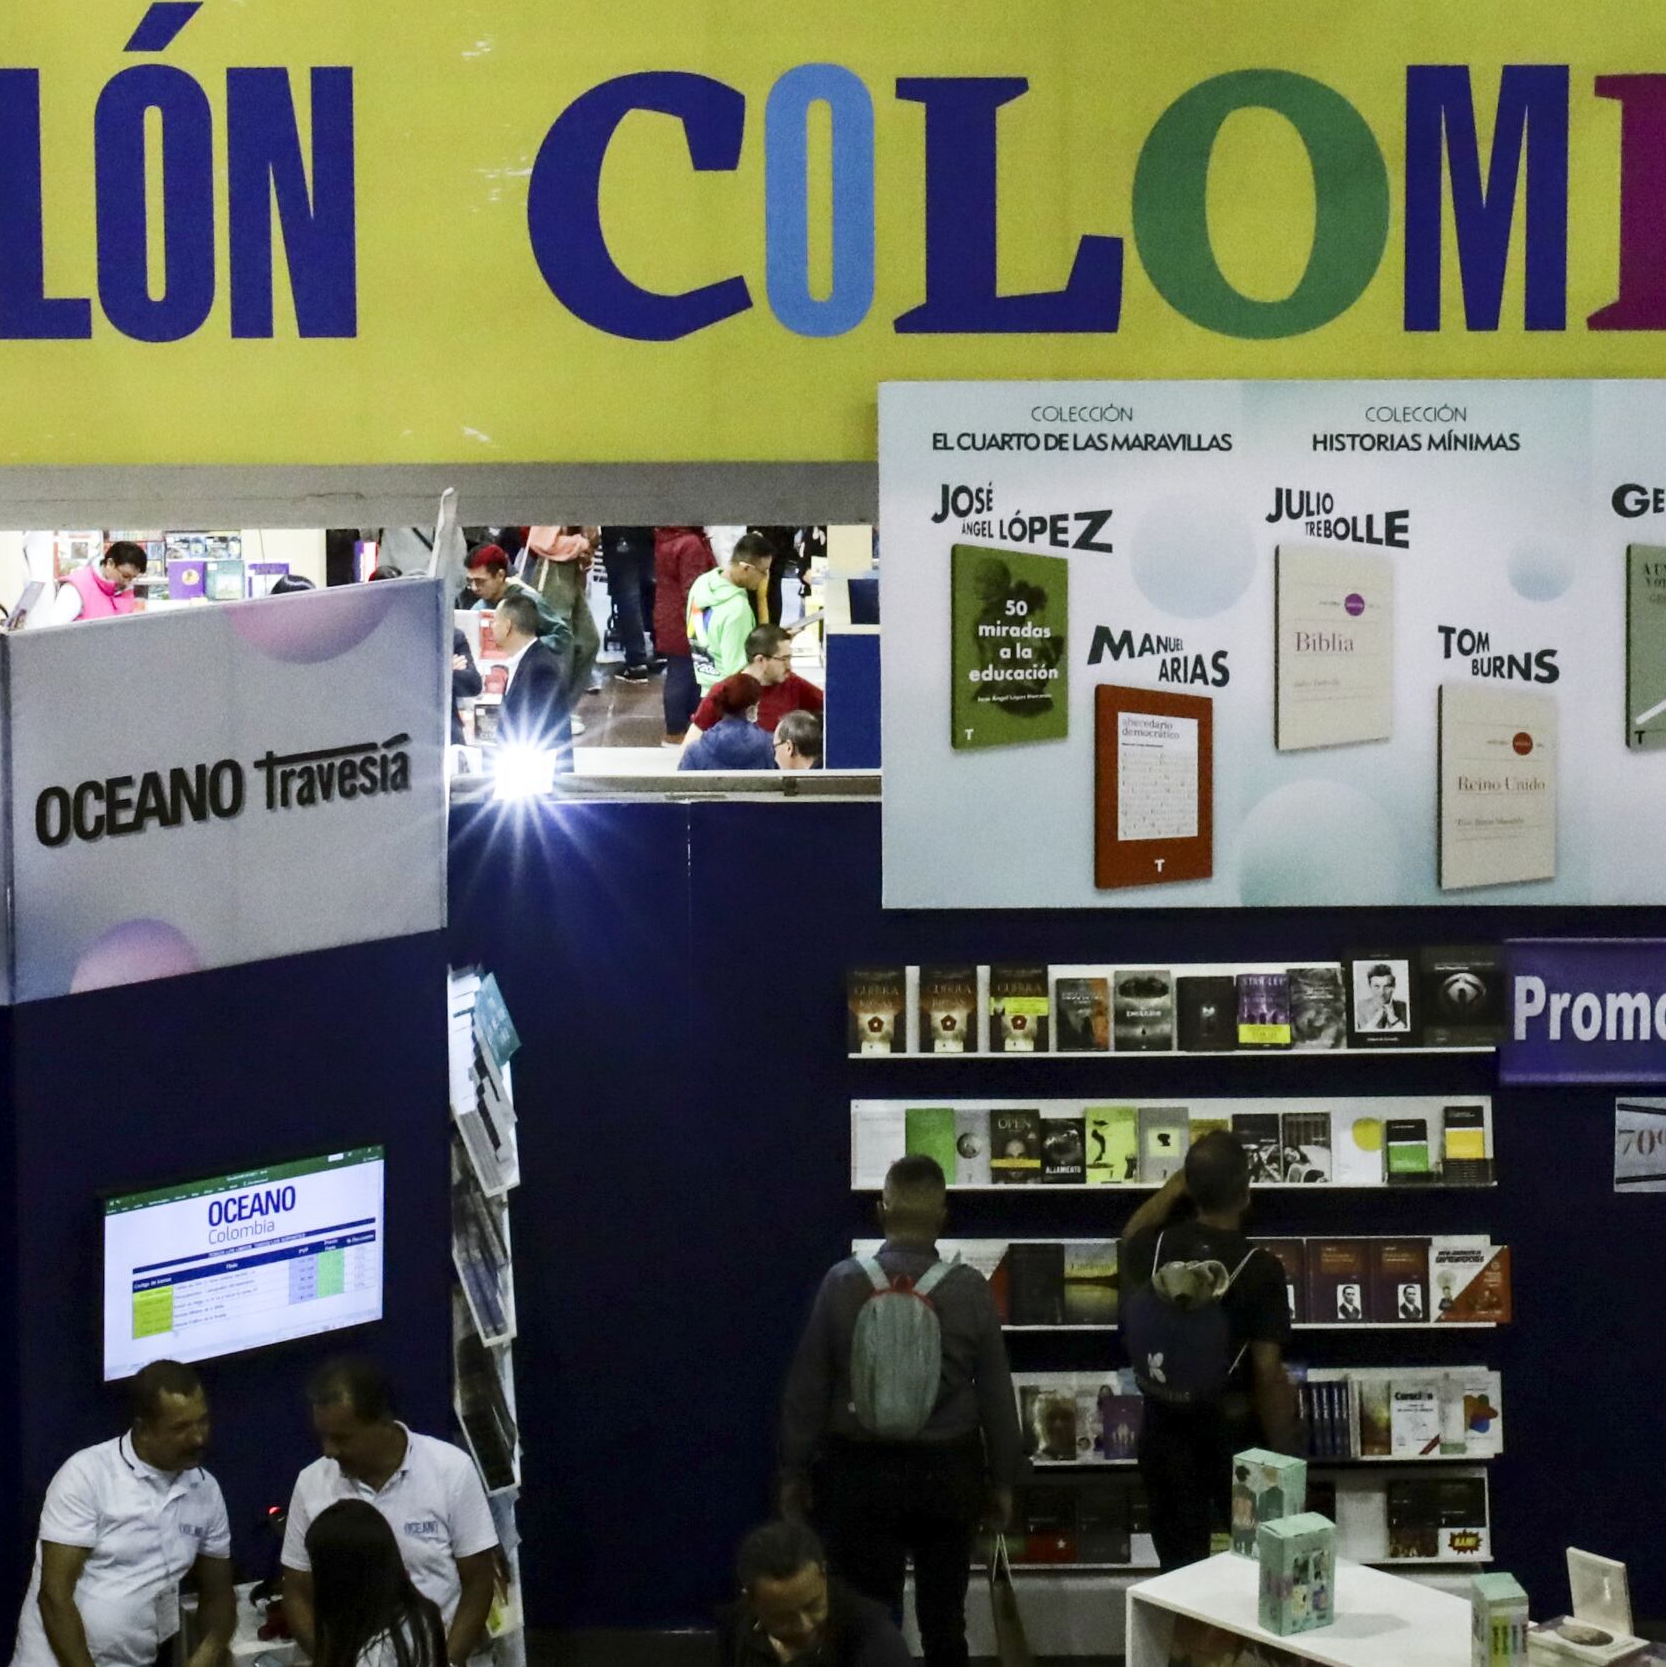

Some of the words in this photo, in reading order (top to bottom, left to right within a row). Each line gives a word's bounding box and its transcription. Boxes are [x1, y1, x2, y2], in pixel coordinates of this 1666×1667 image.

[1031, 403, 1134, 423] COLECCIÓN
[1365, 403, 1467, 423] COLECCIÓN
[932, 432, 954, 452] EL
[955, 432, 1041, 452] CUARTO
[1043, 432, 1069, 452] DE
[1071, 432, 1110, 452] LAS
[1111, 432, 1234, 452] MARAVILLAS
[1312, 432, 1422, 452] HISTORIAS
[1427, 428, 1521, 452] MÍNIMAS
[931, 482, 993, 524] JOSÉ
[1266, 486, 1334, 524] JULIO
[961, 516, 994, 538] ÁNGEL
[999, 508, 1113, 554] LÓPEZ
[1305, 509, 1411, 549] TREBOLLE
[1005, 599, 1028, 616] 50
[978, 620, 1051, 639] miradas
[1087, 624, 1184, 665] MANUEL
[1295, 631, 1354, 653] Biblia
[1437, 624, 1490, 660] TOM
[999, 645, 1011, 660] a
[1016, 642, 1033, 660] la
[1471, 648, 1560, 685] BURNS
[969, 663, 1059, 683] educación
[1158, 650, 1230, 688] ARIAS
[35, 758, 245, 849] OCEANO
[256, 733, 412, 811] Travesía
[208, 1185, 296, 1227] OCEANO
[208, 1219, 276, 1246] Colombia
